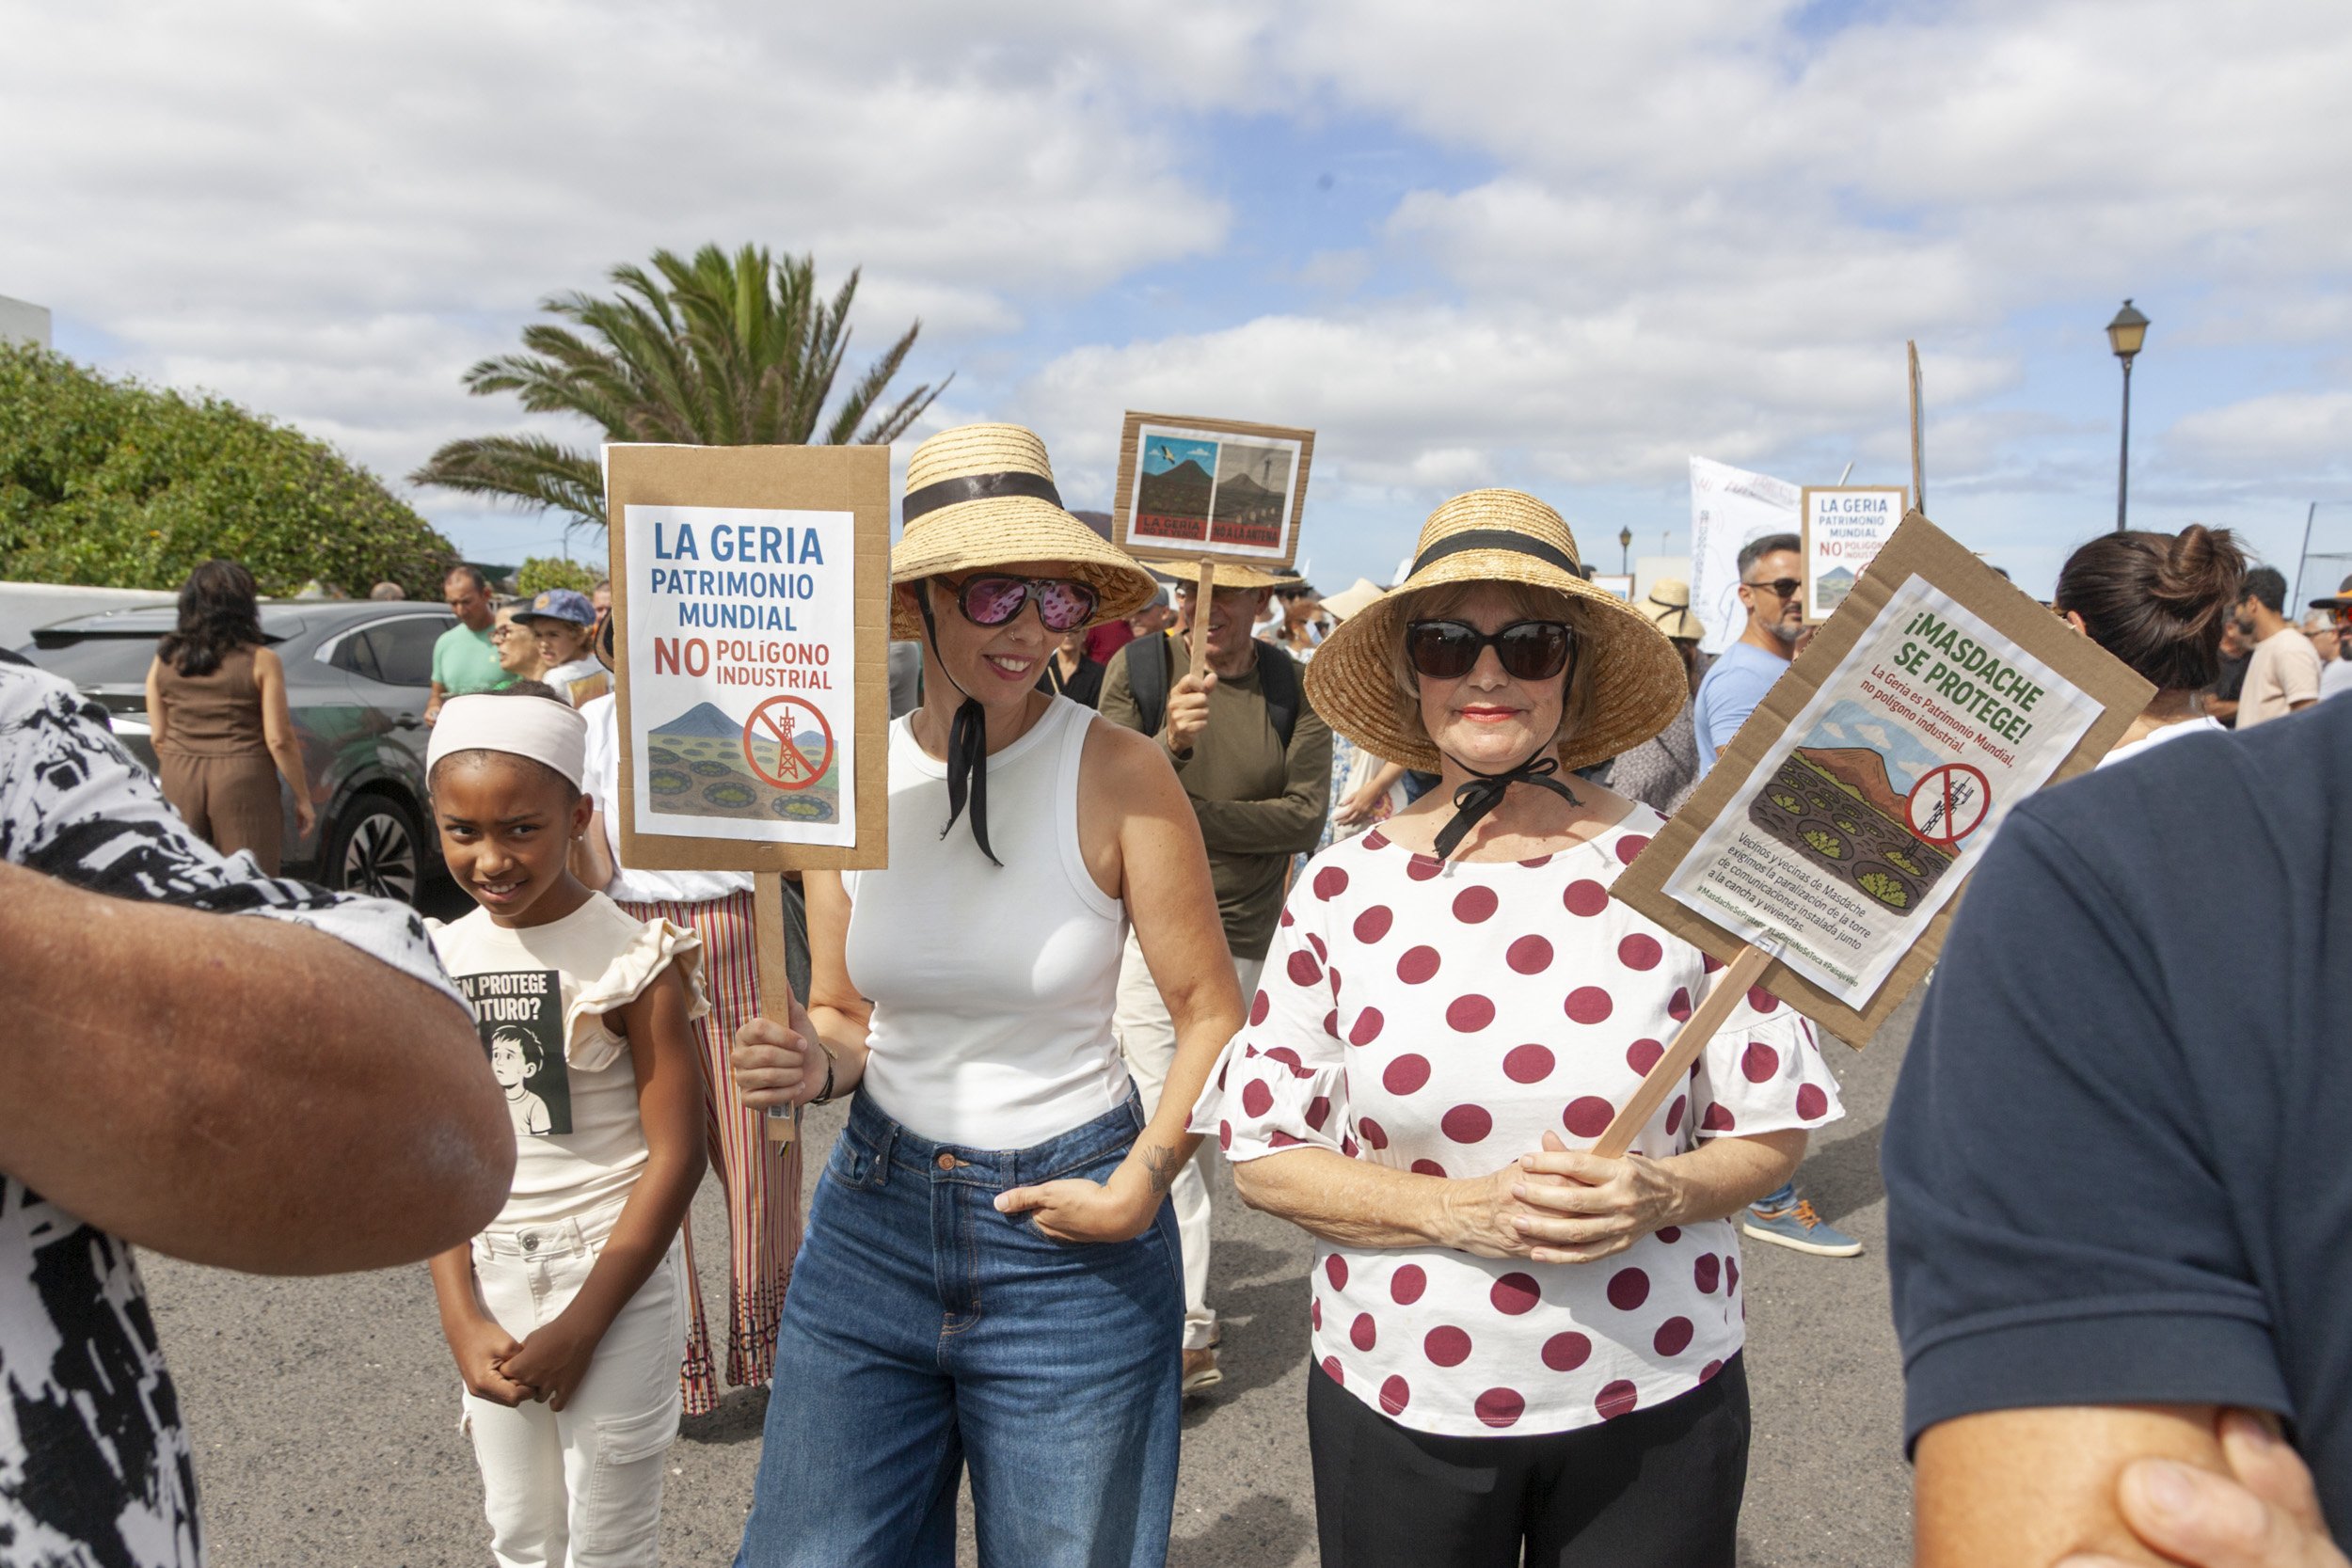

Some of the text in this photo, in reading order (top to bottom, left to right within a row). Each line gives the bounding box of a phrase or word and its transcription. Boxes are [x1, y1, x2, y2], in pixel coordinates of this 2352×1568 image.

[1144, 518, 1200, 530] LA GERIA
[1820, 516, 1884, 526] PATRIMONIO
[1821, 499, 1887, 513] LA GERIA
[654, 522, 823, 565] LA GERIA
[1215, 526, 1225, 537] NO
[1247, 529, 1278, 542] ANTENA
[1820, 542, 1842, 556] NO
[1830, 529, 1877, 537] MUNDIAL
[651, 568, 814, 600] PATRIMONIO
[678, 602, 797, 631] MUNDIAL
[654, 637, 709, 677] NO
[1903, 612, 2044, 712] ¡MASDACHE
[717, 666, 832, 689] INDUSTRIAL
[1894, 641, 2032, 745] SE PROTEGE!
[1860, 679, 1964, 753] no polígono industrial.
[1871, 664, 2016, 768] La Geria es Patrimonio Mundial,
[1727, 845, 1872, 939] exigimos la paralización de la torre
[1739, 832, 1867, 918] Vecinos y vecinas de Masdache
[1696, 885, 1767, 928] #MasdacheSeProtege
[1714, 871, 1724, 884] la
[1724, 879, 1759, 904] cancha
[1755, 898, 1764, 909] y
[1763, 901, 1804, 933] viviendas.
[1718, 857, 1862, 950] de comunicaciones instalada junto
[479, 974, 548, 996] PROTEGE
[470, 997, 541, 1023] UTURO?
